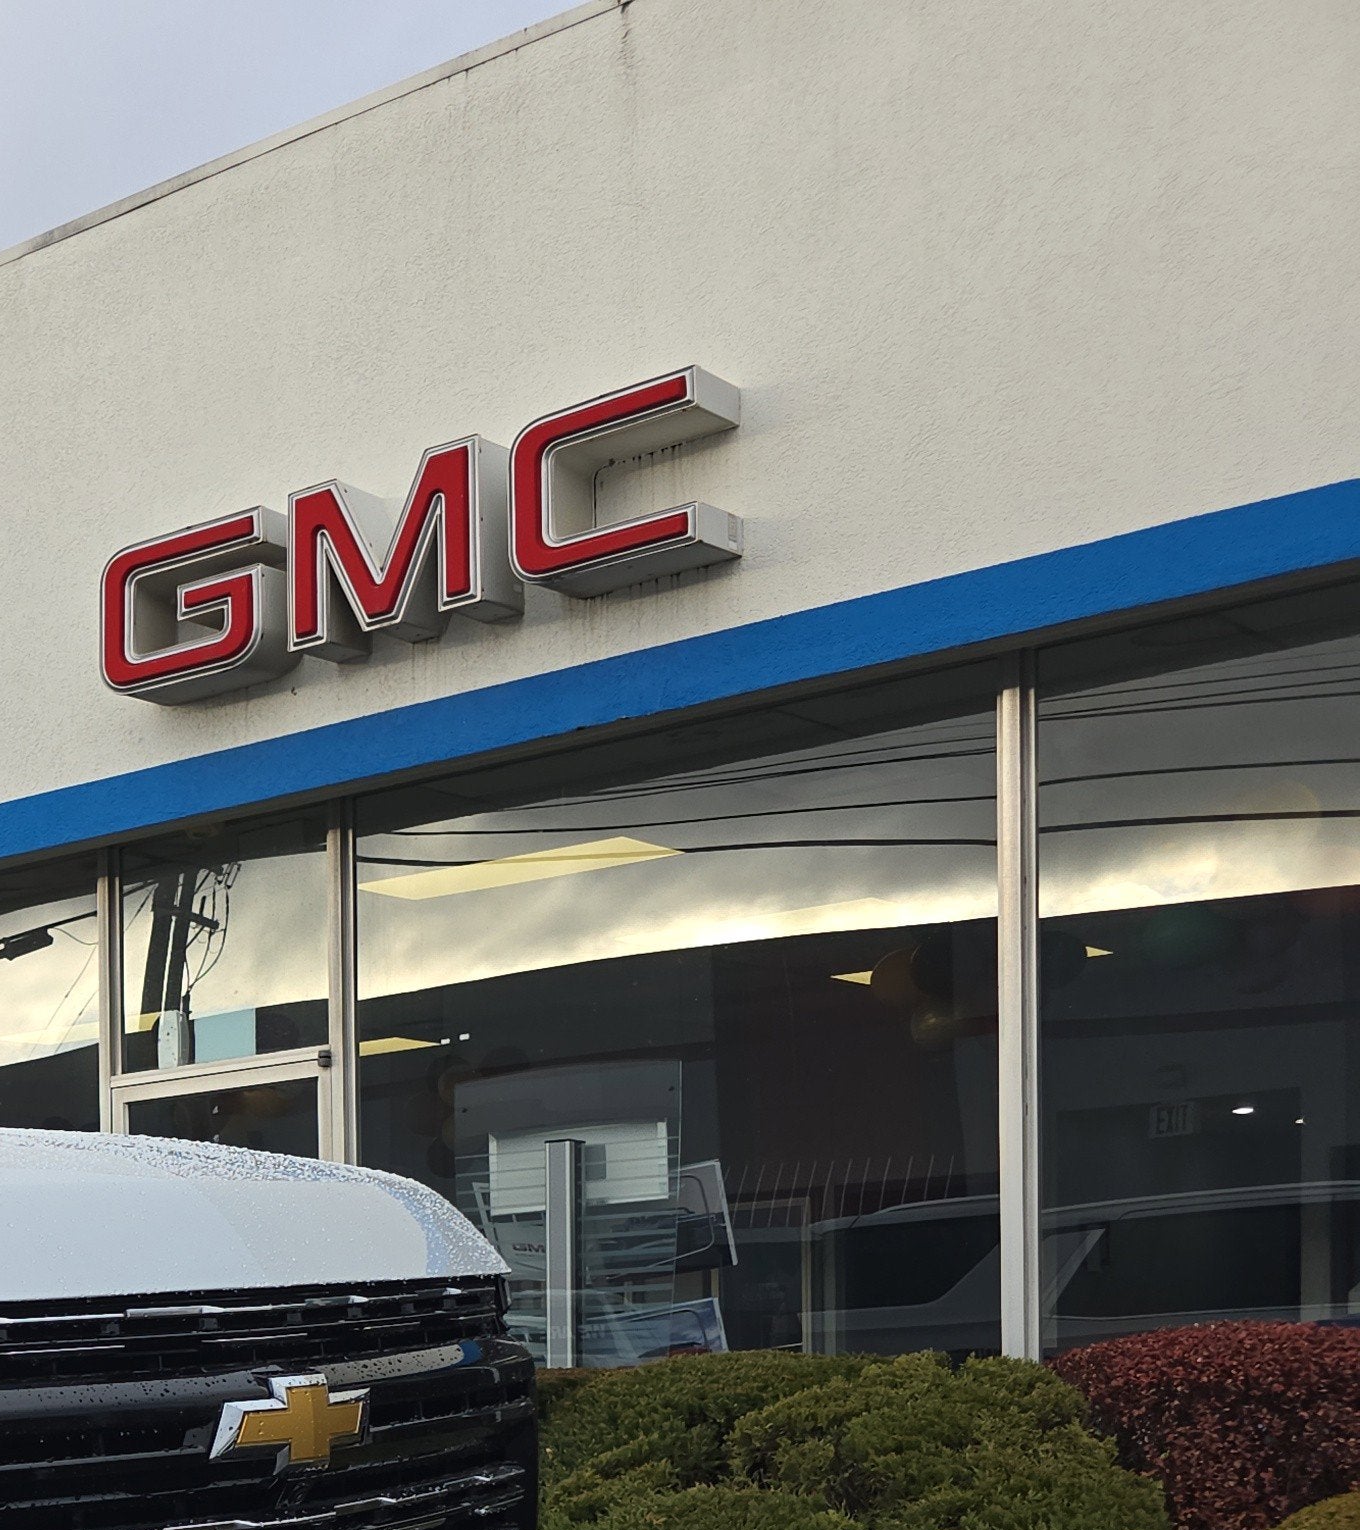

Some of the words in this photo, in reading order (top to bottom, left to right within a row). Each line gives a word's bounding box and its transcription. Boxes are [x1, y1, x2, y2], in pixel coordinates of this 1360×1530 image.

[100, 365, 743, 706] GMC
[1156, 1106, 1189, 1134] EXIT
[512, 1243, 546, 1253] GM
